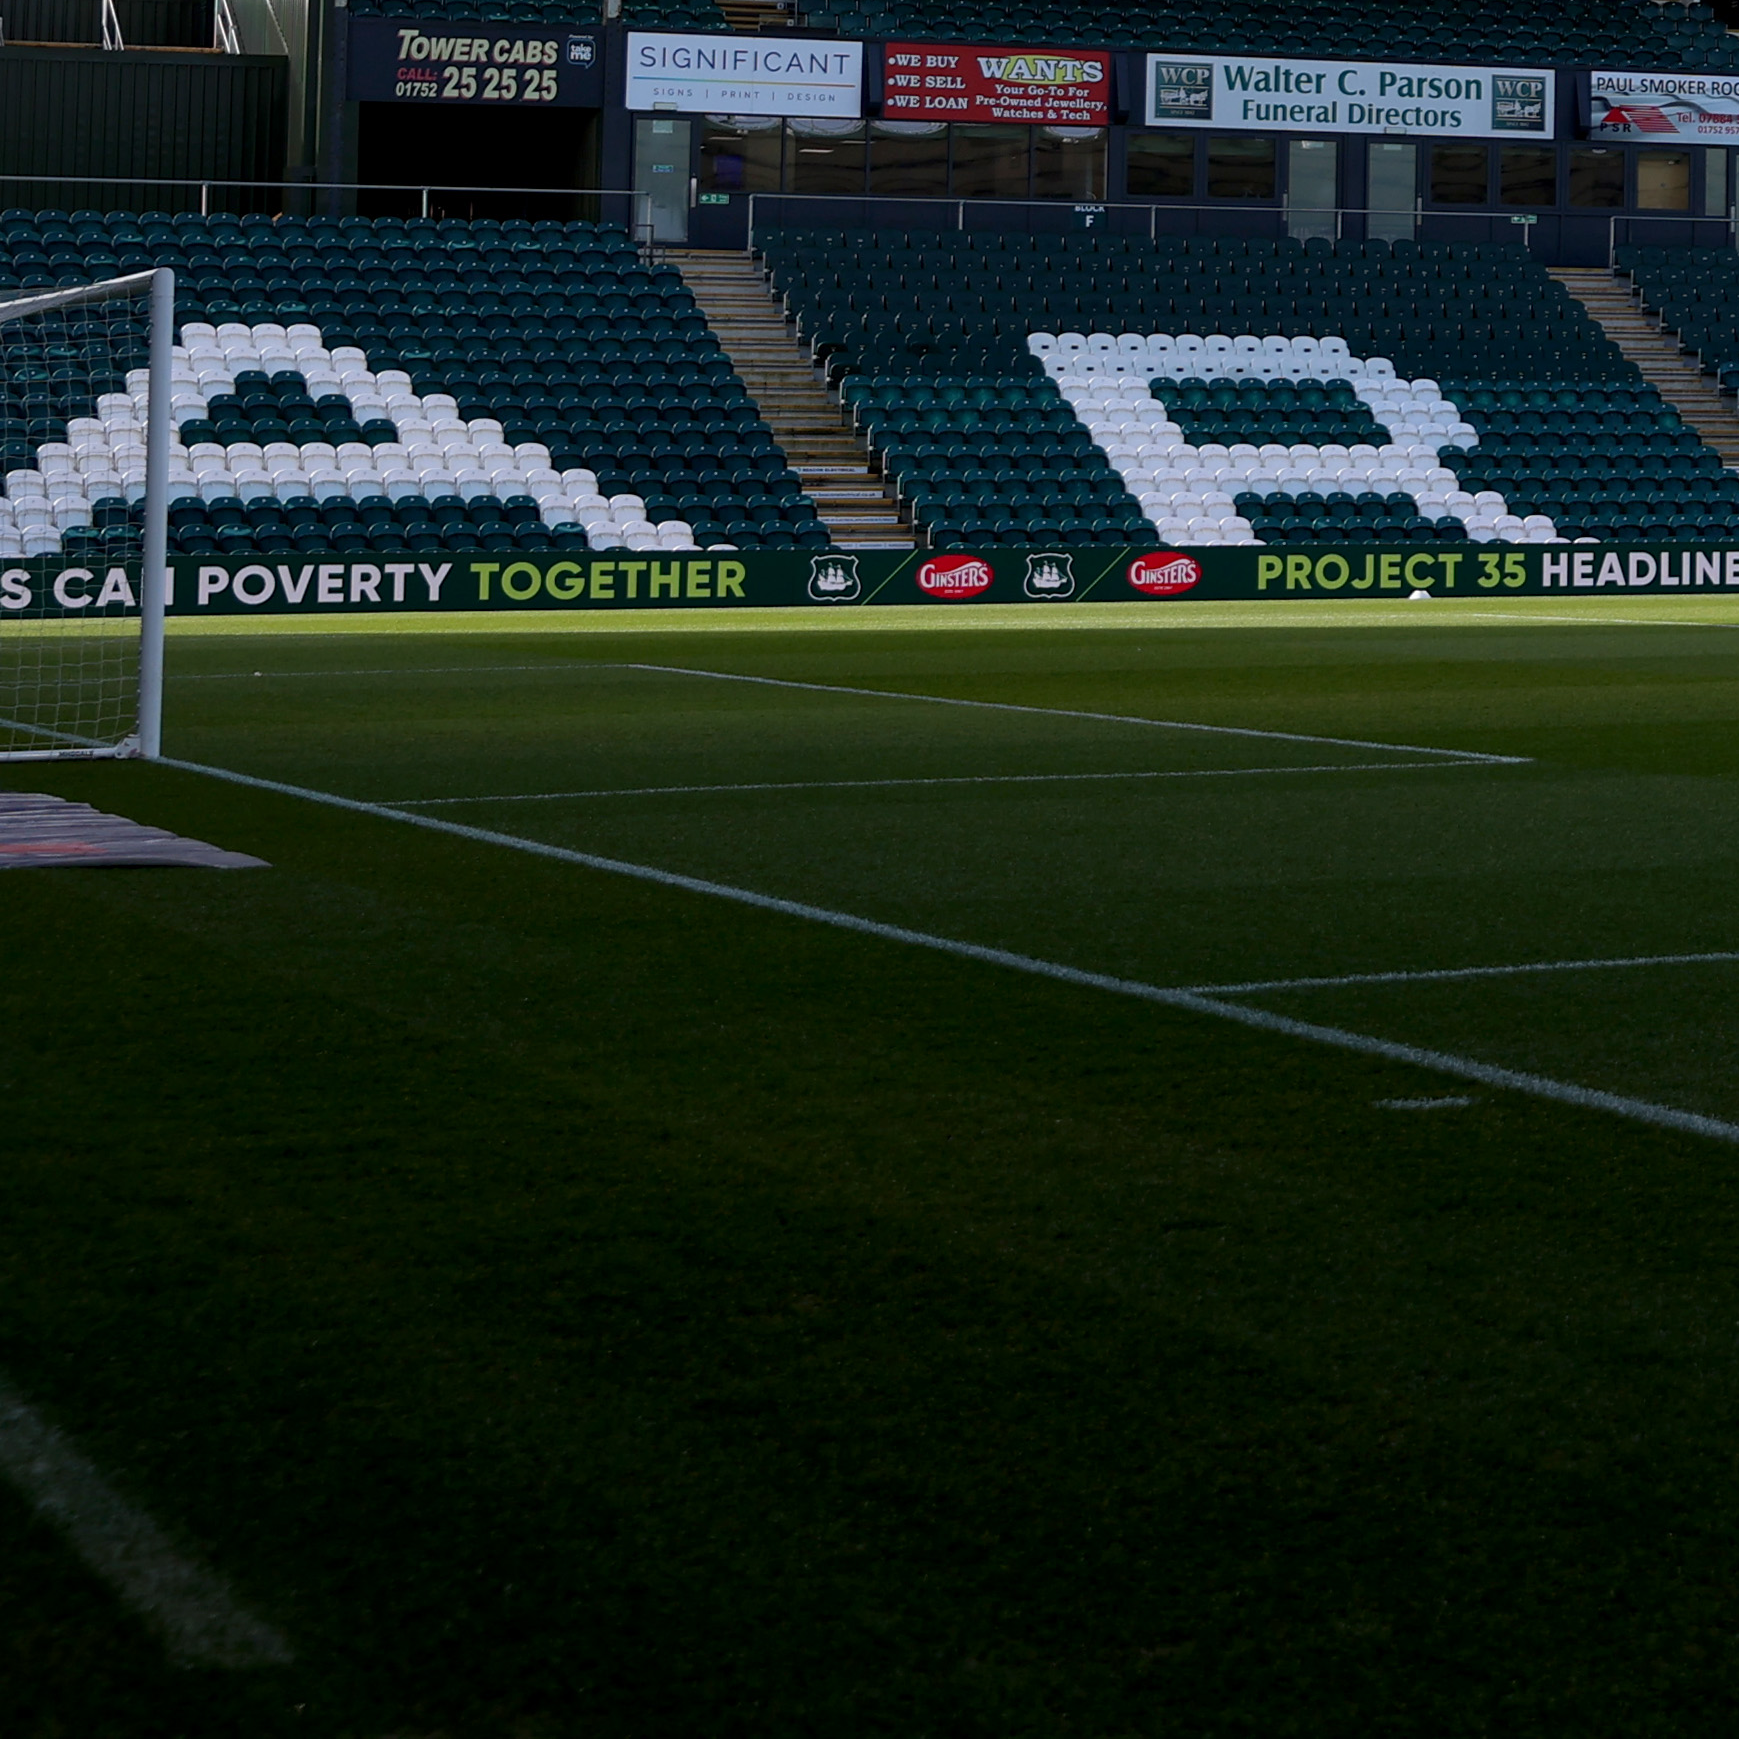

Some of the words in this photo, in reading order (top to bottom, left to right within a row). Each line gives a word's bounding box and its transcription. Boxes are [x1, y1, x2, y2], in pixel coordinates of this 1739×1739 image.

[396, 28, 489, 64] TOWER
[492, 39, 559, 66] CABS
[570, 43, 592, 54] take
[570, 51, 592, 62] me
[640, 46, 851, 75] SIGNIFICANT
[896, 54, 921, 67] WE
[926, 55, 959, 68] BUY
[397, 67, 438, 81] CALL:
[977, 56, 1104, 82] WANTS
[1160, 66, 1210, 85] WCP
[395, 82, 438, 98] 01752
[441, 66, 478, 100] 25
[482, 67, 518, 101] 25
[522, 68, 559, 102] 25
[896, 75, 921, 87] WE
[925, 76, 966, 90] SELL
[1224, 65, 1326, 94] Walter
[1338, 69, 1366, 96] C.
[1379, 71, 1482, 100] Parson
[1597, 77, 1636, 92] PAUL
[1640, 79, 1706, 94] SMOKER
[653, 87, 694, 97] SIGNS
[721, 90, 760, 100] PRINT
[787, 93, 836, 102] DESIGN
[995, 84, 1024, 96] Your
[1028, 85, 1065, 97] Go-To
[1068, 87, 1090, 98] For
[895, 95, 921, 108] WE
[925, 96, 968, 109] LOAN
[976, 95, 1043, 108] Pre-Owned
[1045, 97, 1107, 112] Jewellery,
[992, 107, 1043, 119] Watches
[1047, 109, 1058, 120] &
[1060, 109, 1091, 121] Tech
[1243, 100, 1337, 124] Funeral
[1349, 103, 1462, 128] Directors
[1677, 112, 1696, 123] Tel.
[1699, 113, 1733, 125] 07884
[1698, 125, 1724, 135] 01752
[1257, 553, 1463, 591] PROJECT
[1477, 552, 1526, 589] 35
[198, 562, 453, 607] POVERTY
[470, 560, 747, 602] TOGETHER
